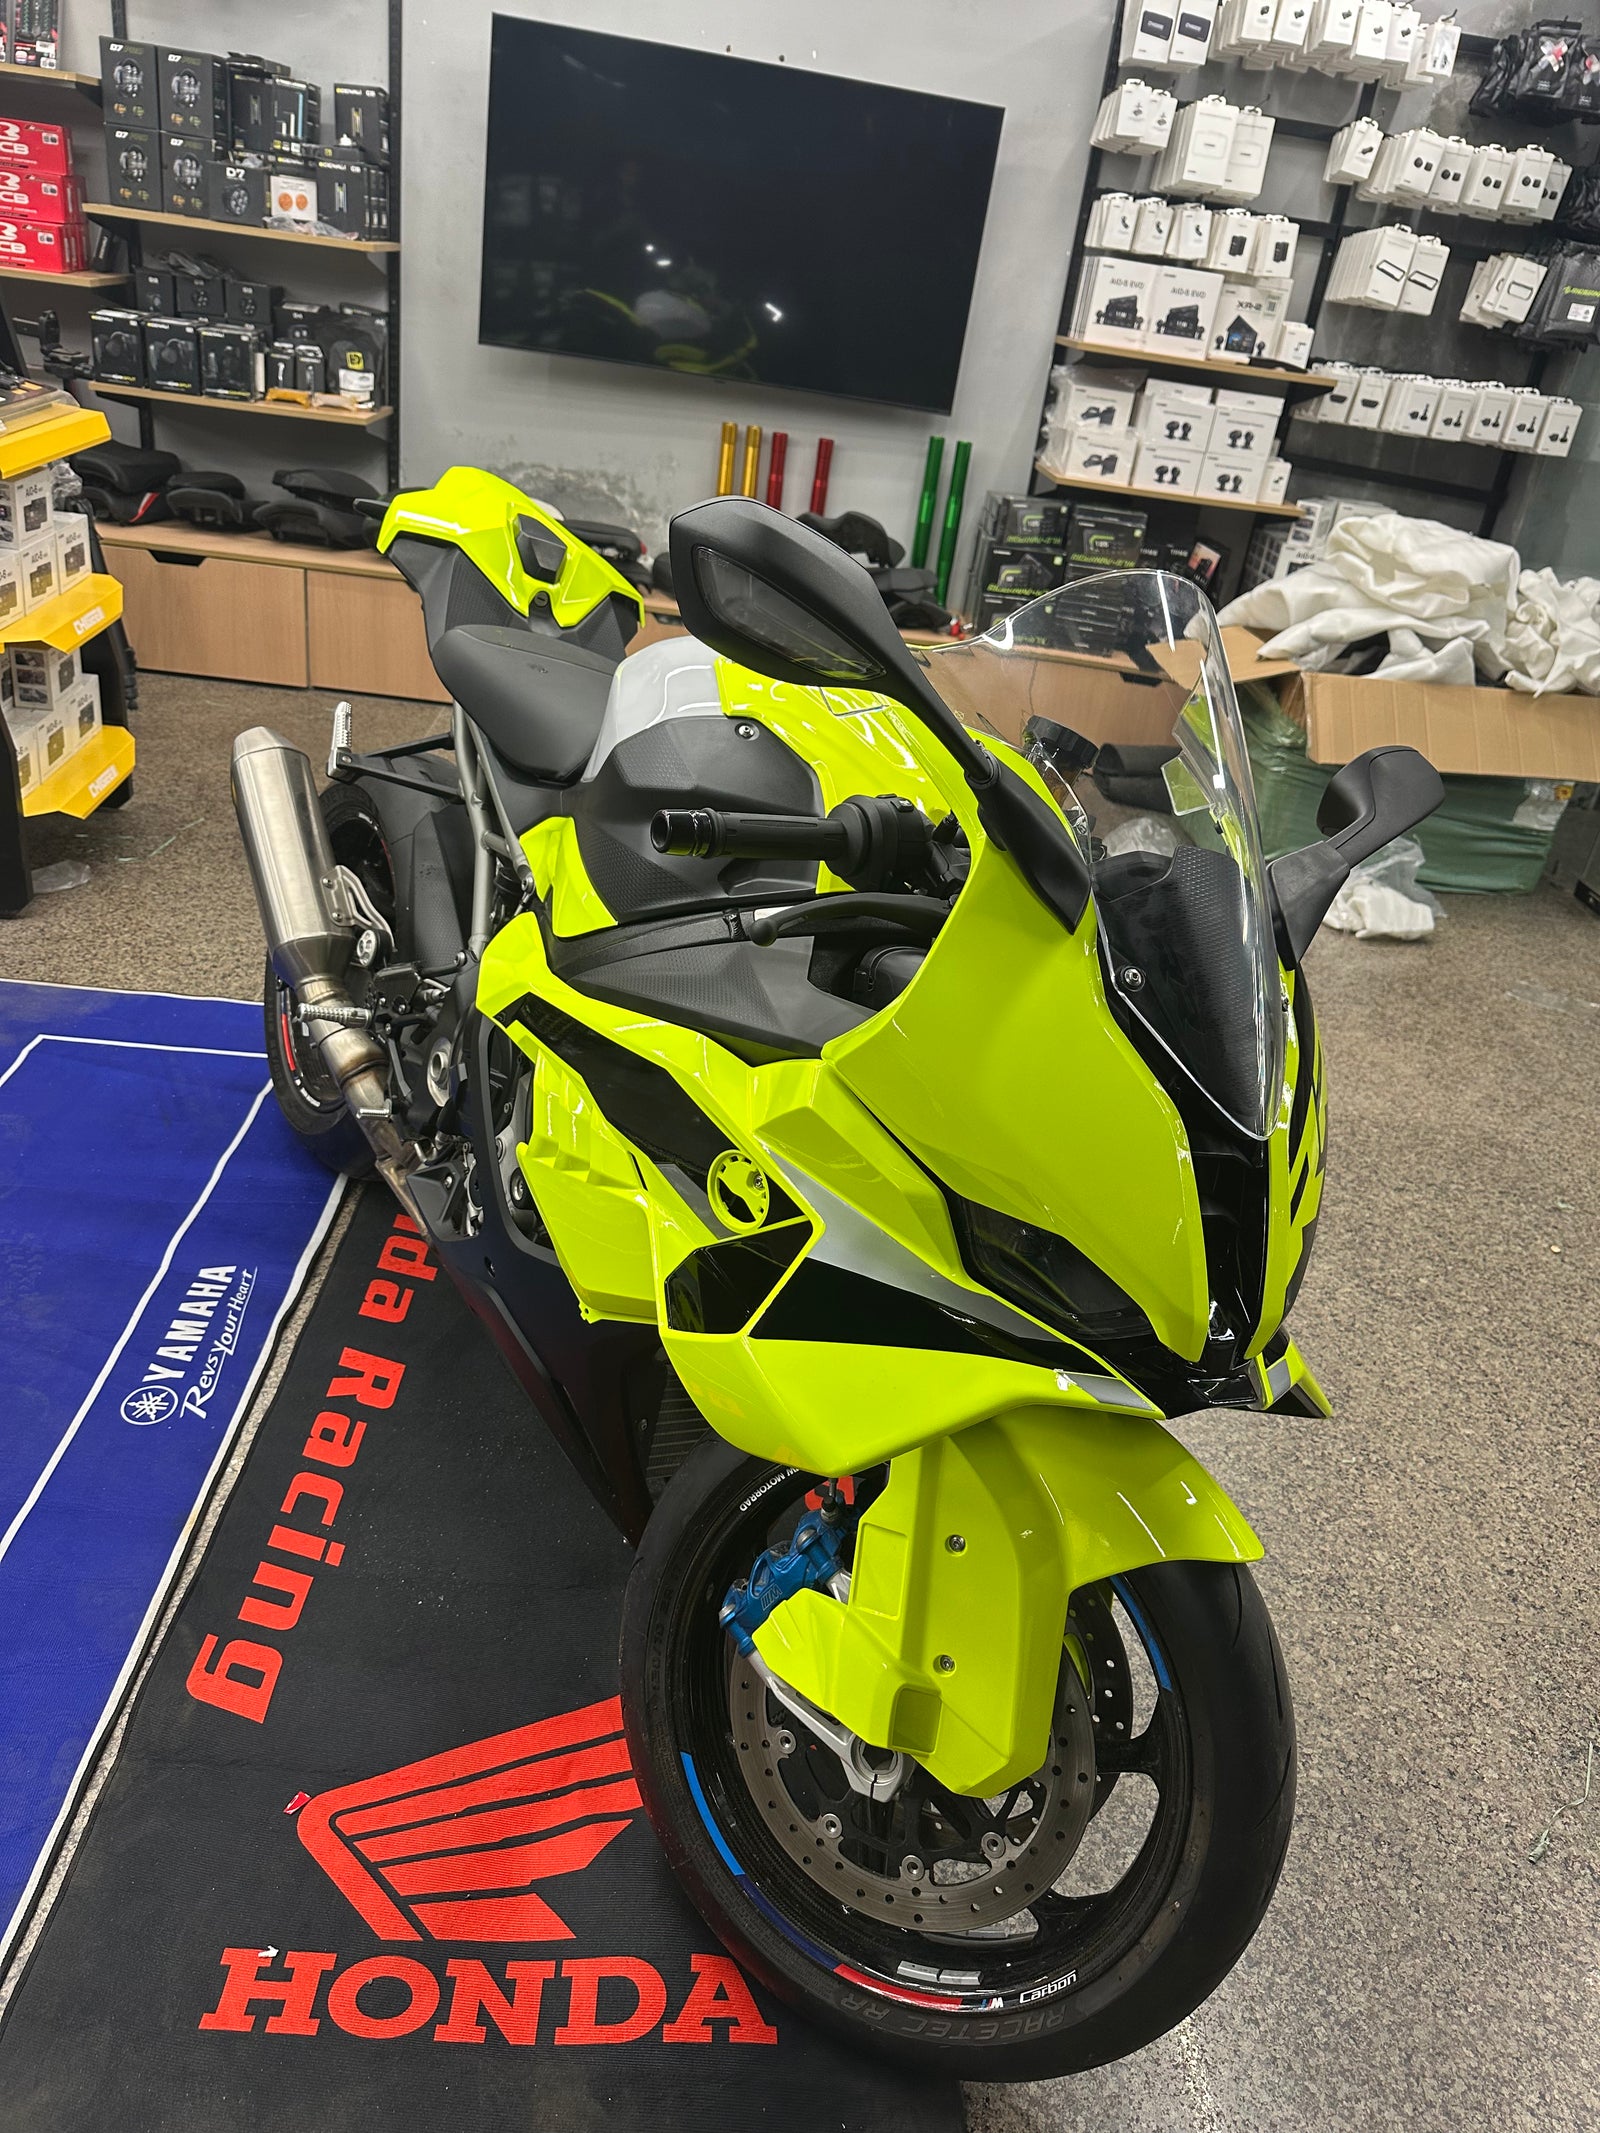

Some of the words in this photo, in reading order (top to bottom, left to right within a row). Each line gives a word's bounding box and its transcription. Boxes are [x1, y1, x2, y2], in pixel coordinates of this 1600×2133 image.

[226, 166, 246, 179] D7
[142, 1265, 237, 1383] YAMAHA
[180, 1353, 220, 1419] Revs
[210, 1309, 239, 1357] Your
[227, 1267, 254, 1312] Heart
[738, 1473, 788, 1512] MOTORRAD
[186, 1346, 406, 1724] Racing
[199, 1947, 777, 2046] HONDA
[1019, 1968, 1078, 2005] Carbon
[840, 1995, 891, 2021] RR
[901, 2003, 1068, 2041] RACETEC
